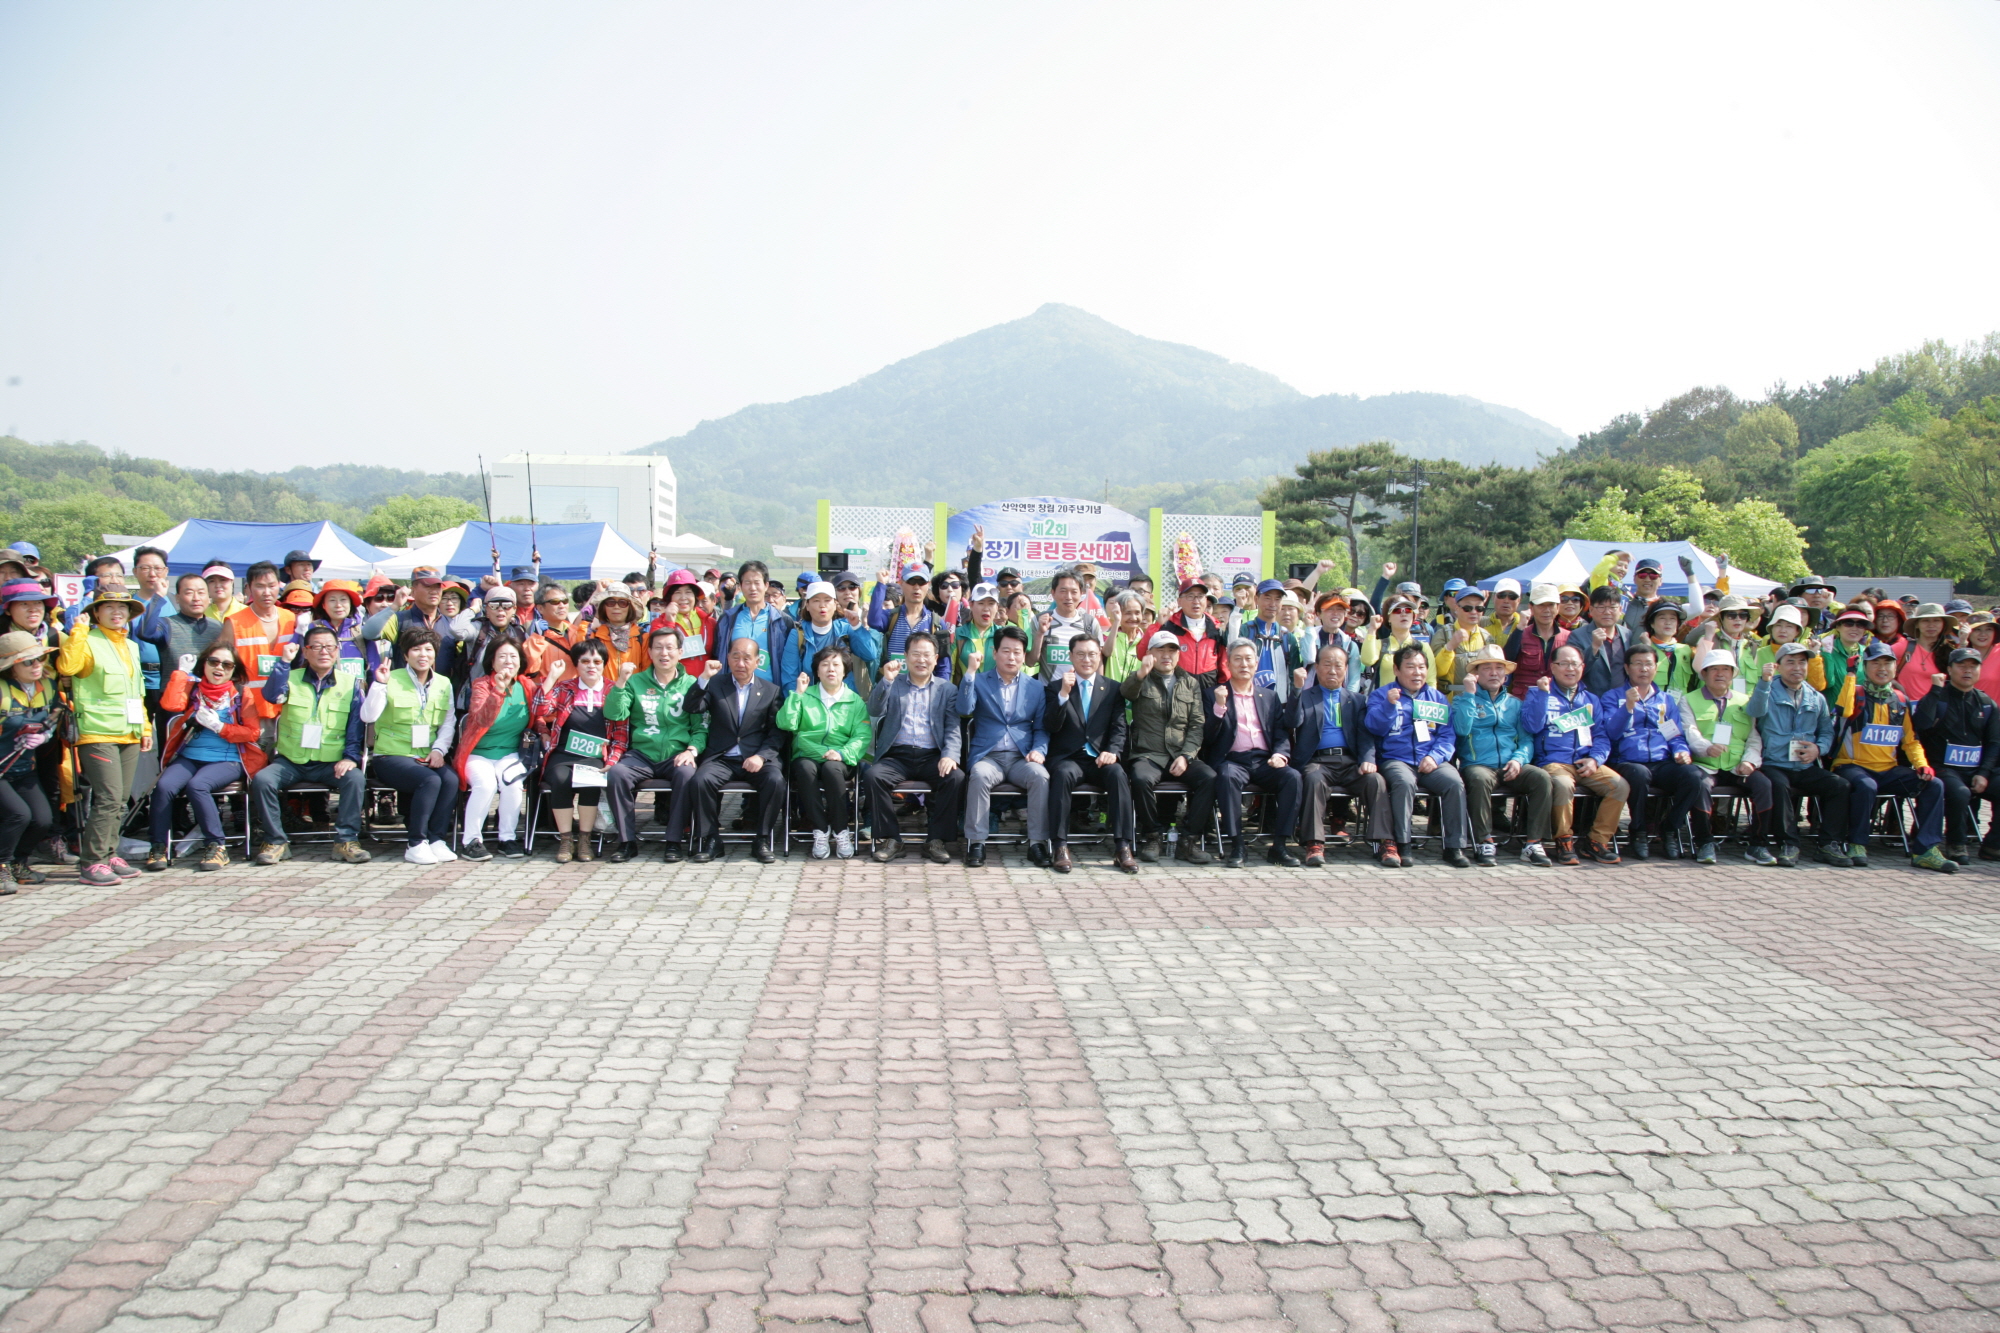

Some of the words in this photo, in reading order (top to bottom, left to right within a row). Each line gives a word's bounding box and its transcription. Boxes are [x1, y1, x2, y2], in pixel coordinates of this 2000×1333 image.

[1001, 503, 1035, 513] 산악연맹
[1038, 503, 1055, 513] 창립
[1057, 504, 1101, 514] 20주년기념
[1031, 519, 1067, 536] 제2회
[981, 541, 1019, 559] 장기
[1026, 541, 1130, 561] 클린등산대회
[339, 662, 362, 675] 309
[670, 692, 684, 717] 3
[1418, 704, 1445, 720] B292
[1864, 728, 1899, 743] A1148
[570, 736, 600, 755] B281
